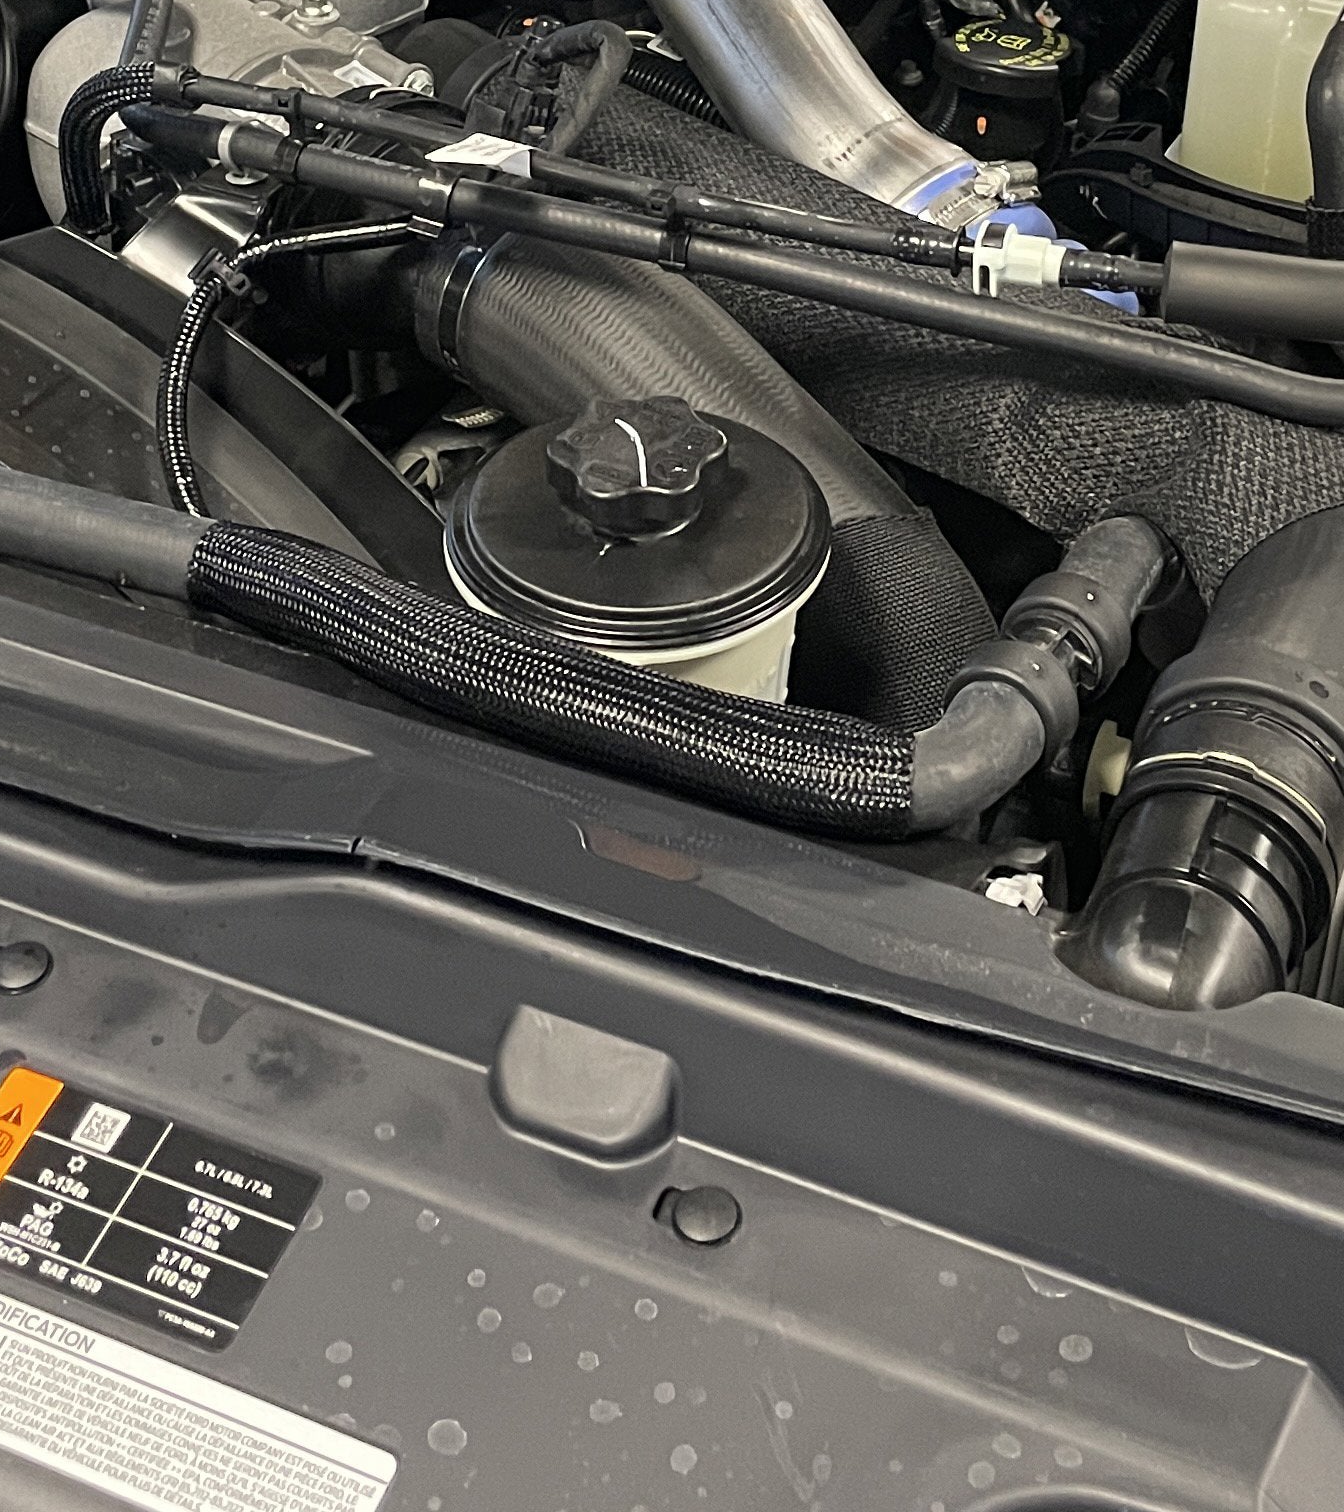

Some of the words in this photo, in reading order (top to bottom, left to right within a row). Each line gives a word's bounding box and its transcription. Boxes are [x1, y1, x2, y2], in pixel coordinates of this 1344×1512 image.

[35, 1167, 94, 1200] R-134a
[16, 1212, 57, 1237] PAG
[215, 1209, 244, 1232] kg
[35, 1258, 72, 1281] SAE
[66, 1270, 106, 1294] J639
[153, 1245, 183, 1267] 3.7
[187, 1261, 213, 1279] oz
[141, 1263, 182, 1290] (110
[172, 1275, 206, 1299] cc)
